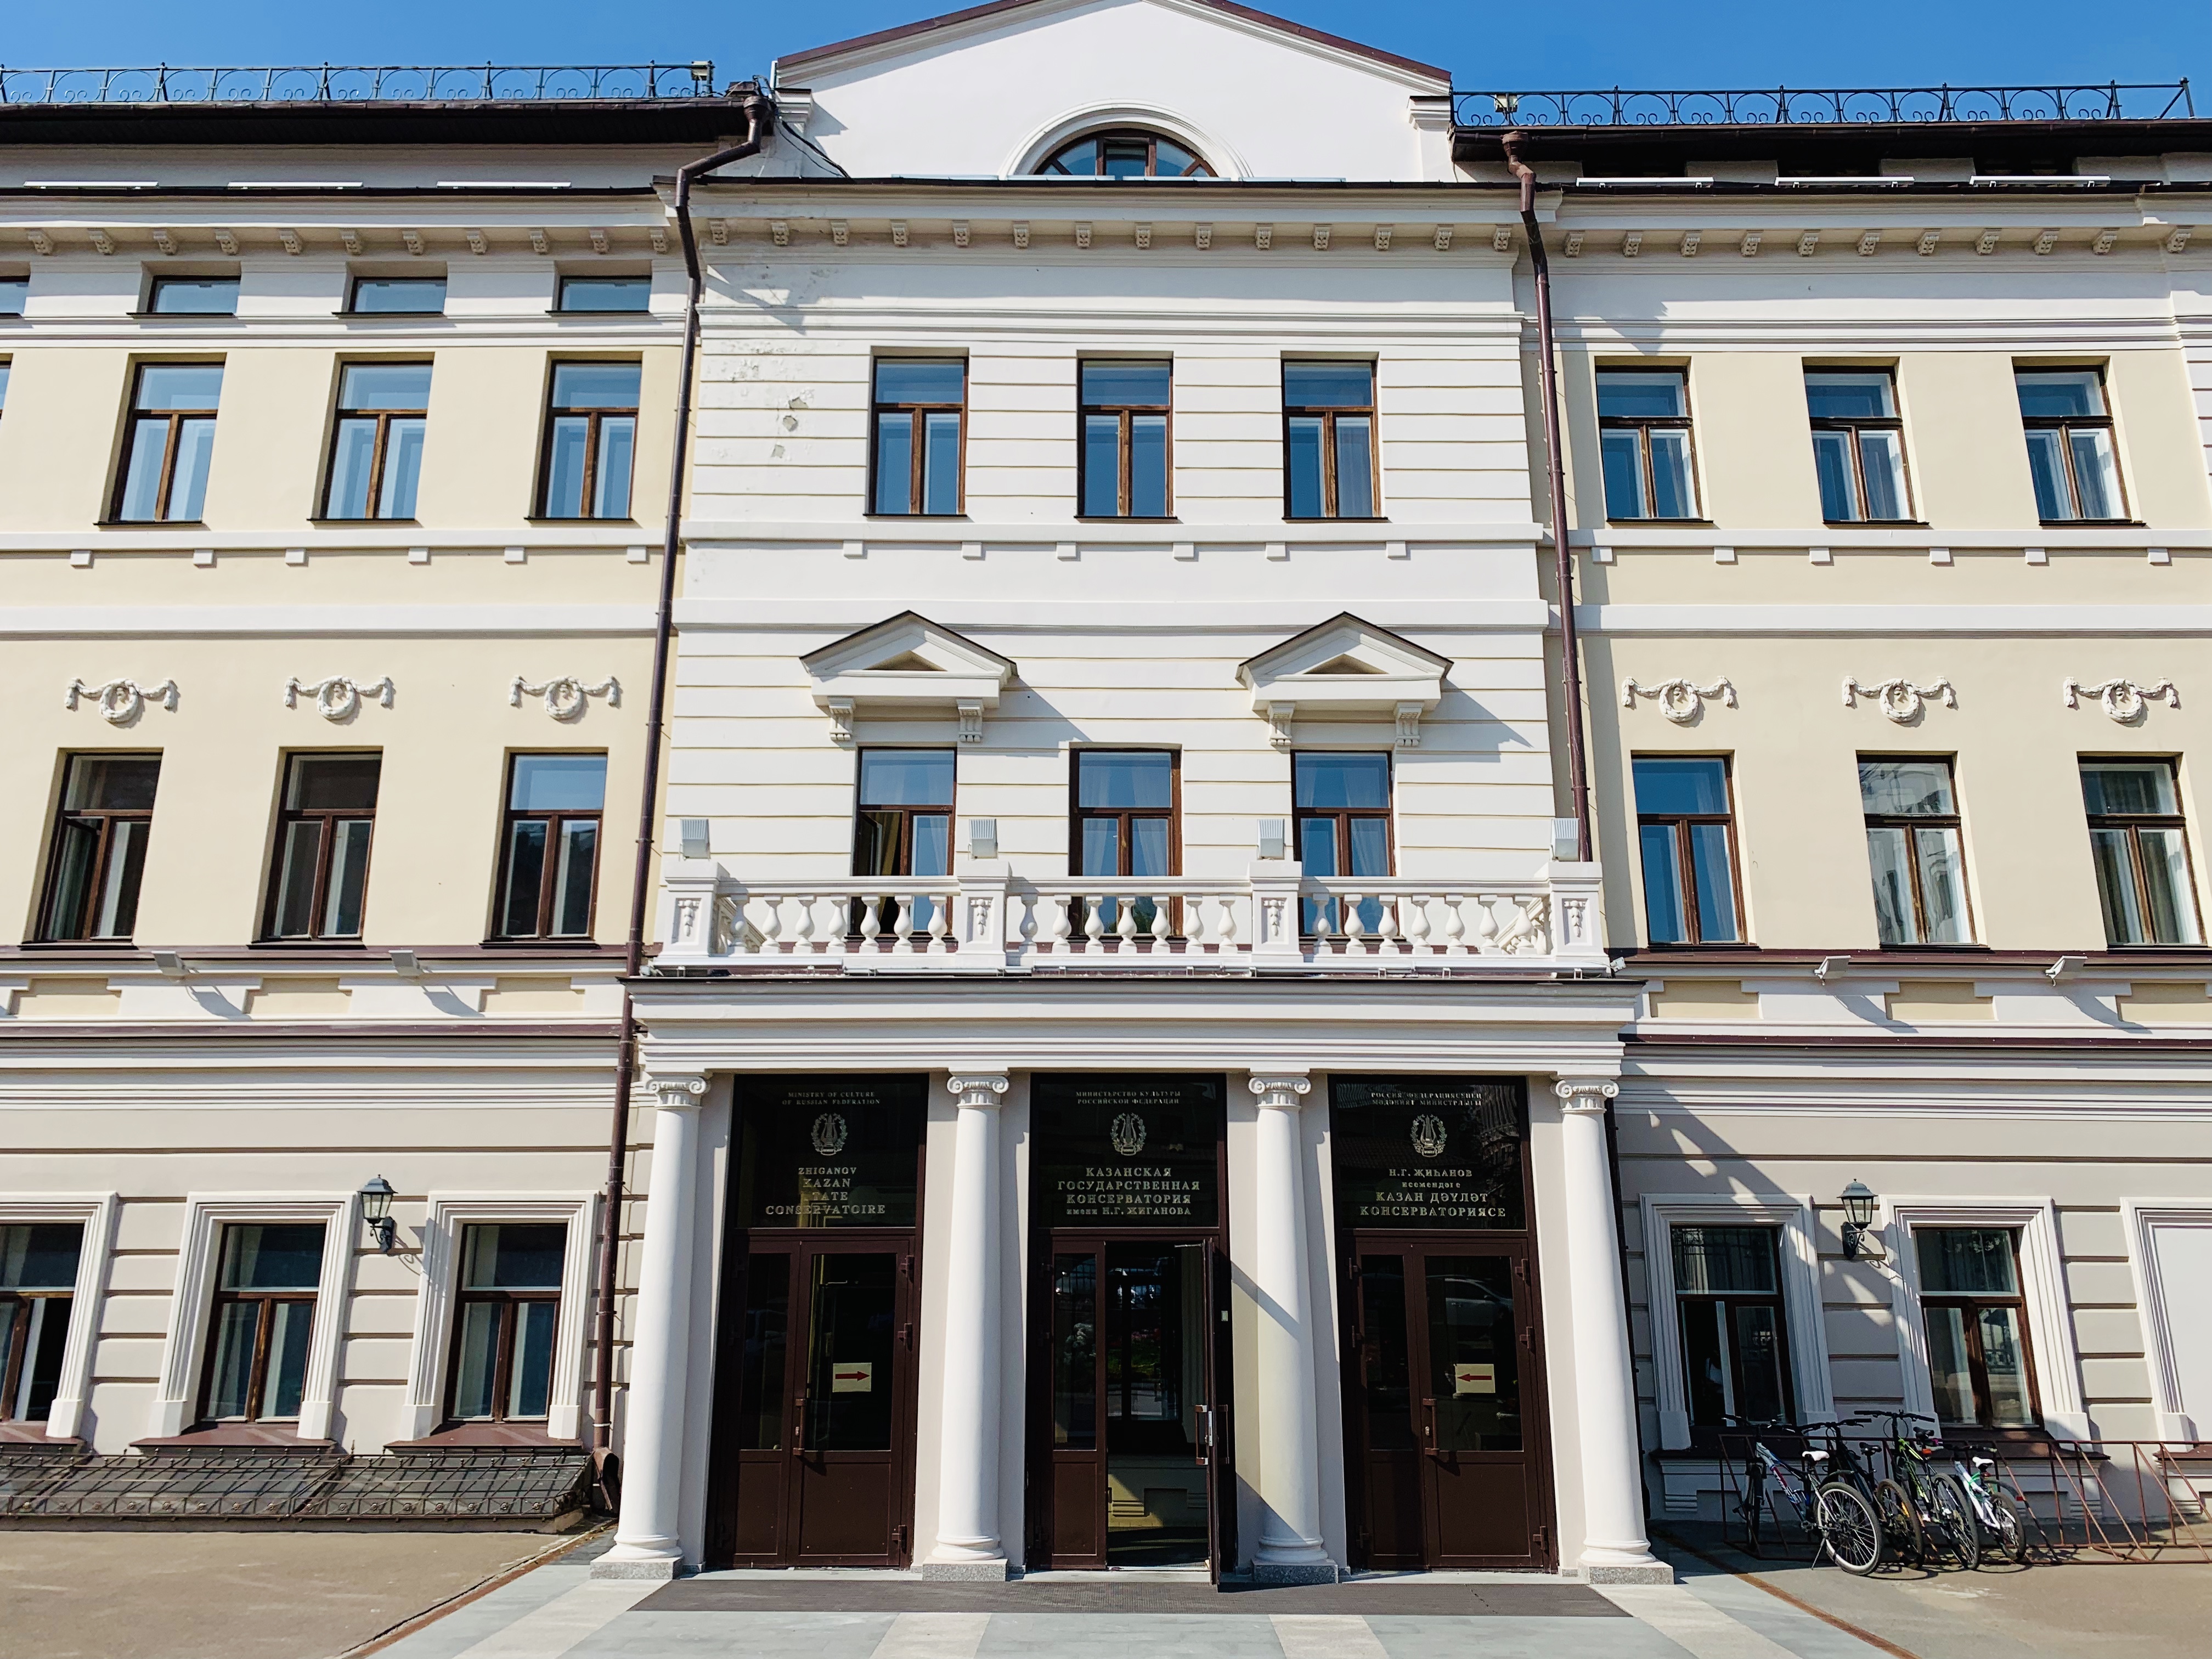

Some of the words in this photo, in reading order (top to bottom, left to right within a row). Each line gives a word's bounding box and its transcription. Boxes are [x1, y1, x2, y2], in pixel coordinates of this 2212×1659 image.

[1086, 1167, 1171, 1177] КАЗАНСКАЯ
[803, 1178, 851, 1187] KAZAN
[1058, 1181, 1200, 1192] ГОСУДАРСТВЕННАЯ
[1066, 1194, 1191, 1204] КОНСЕРВАТОРИЯ
[1376, 1192, 1424, 1201] КАЗАН
[765, 1205, 885, 1215] CONSERVATOIRE
[1360, 1206, 1506, 1217] КОНСЕРВАТОРИЯСЕ
